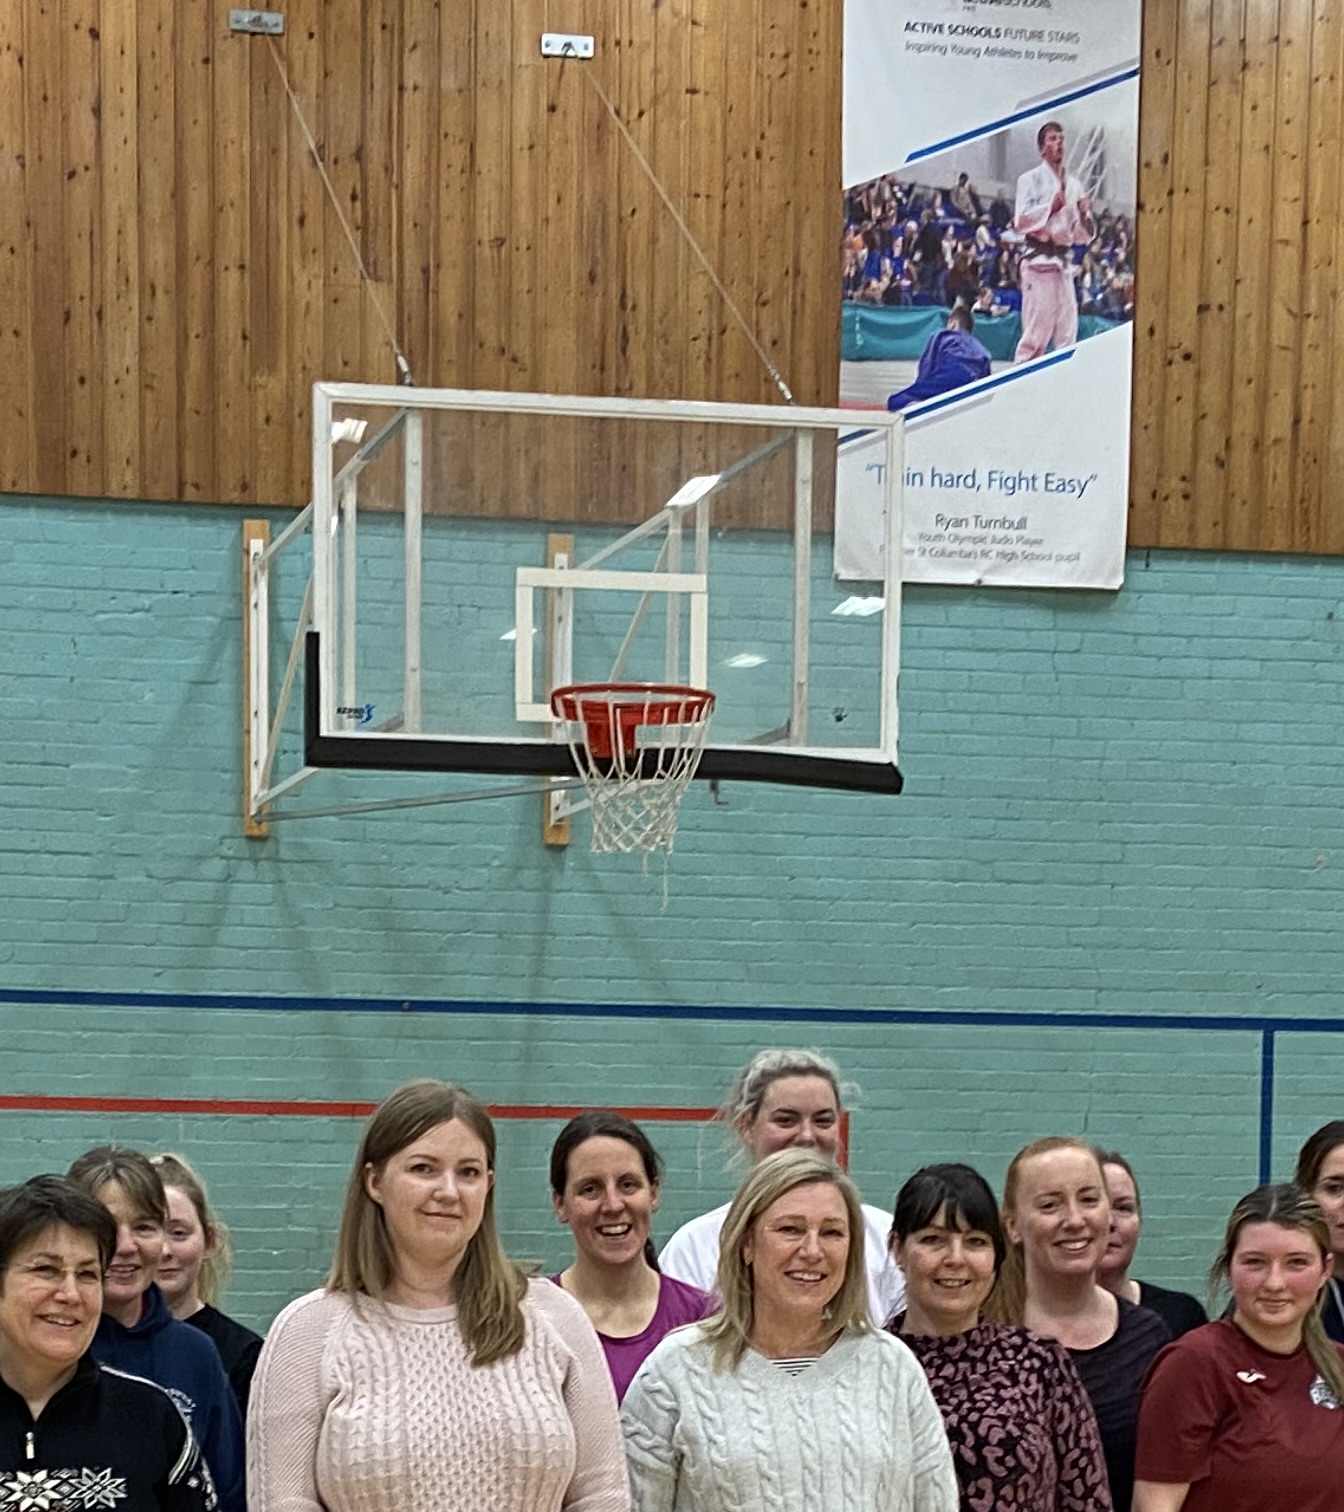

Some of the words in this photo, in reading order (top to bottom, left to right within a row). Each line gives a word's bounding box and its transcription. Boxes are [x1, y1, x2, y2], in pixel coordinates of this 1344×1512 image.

[904, 21, 946, 34] ACTIVE
[948, 23, 1002, 39] SCHOOLS
[865, 463, 924, 488] "Tin
[931, 466, 982, 494] hard,
[987, 469, 1038, 496] Fight
[1044, 472, 1098, 499] Easy"
[935, 513, 969, 532] Ryan
[973, 514, 1028, 530] Turnbull
